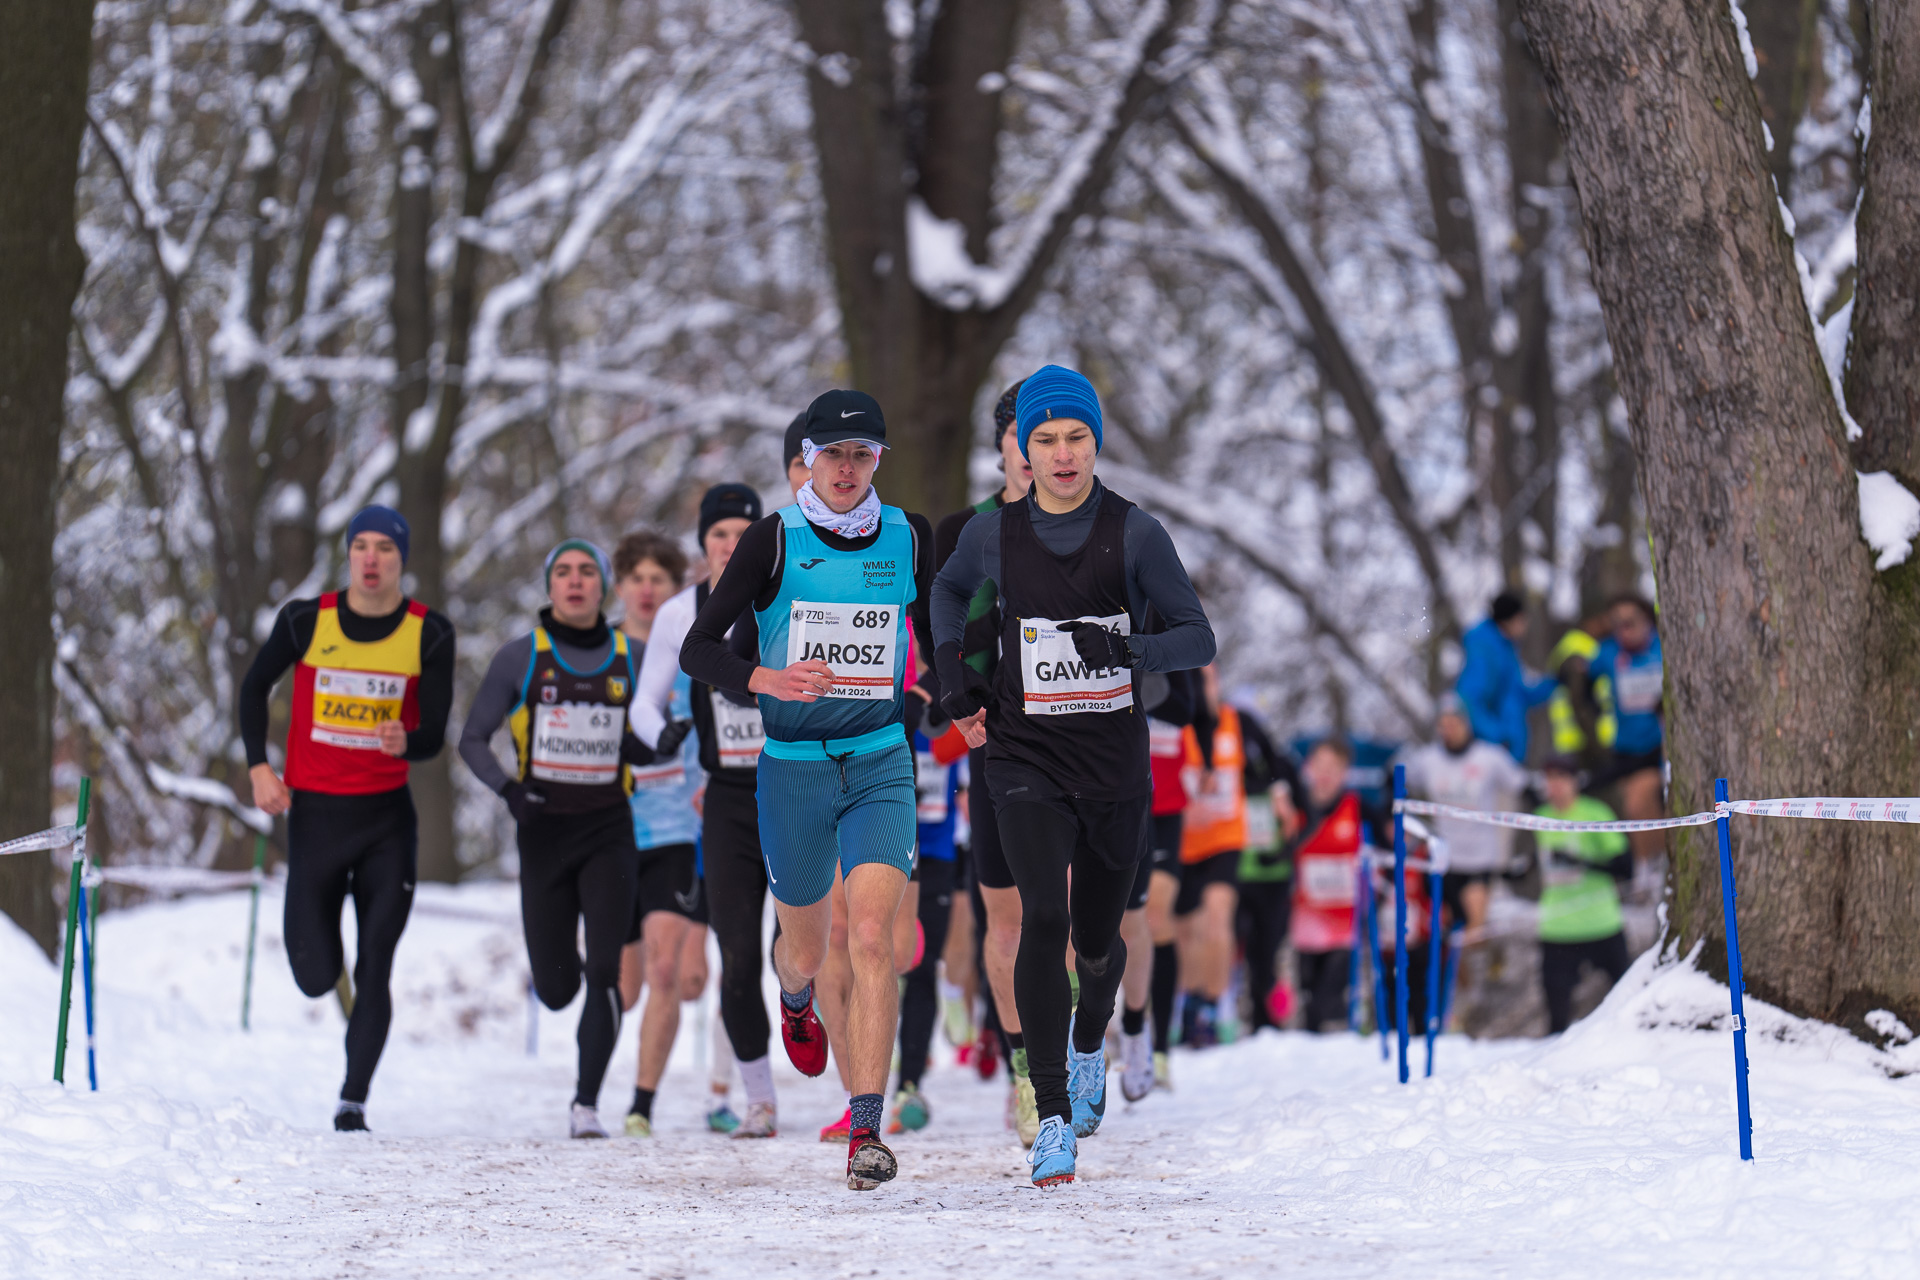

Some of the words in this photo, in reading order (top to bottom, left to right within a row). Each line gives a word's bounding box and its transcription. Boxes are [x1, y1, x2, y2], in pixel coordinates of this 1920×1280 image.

[862, 560, 896, 570] WMLKS
[863, 570, 897, 578] Pomorze
[864, 577, 894, 590] Stargard
[806, 610, 824, 620] 770
[852, 610, 890, 629] 689
[799, 642, 886, 665] JAROSZ
[366, 678, 399, 696] 516
[848, 688, 872, 697] 2024
[322, 699, 395, 722] ZACZYK
[1050, 702, 1086, 713] BYTOM
[1088, 701, 1112, 710] 2024
[589, 711, 612, 729] 63
